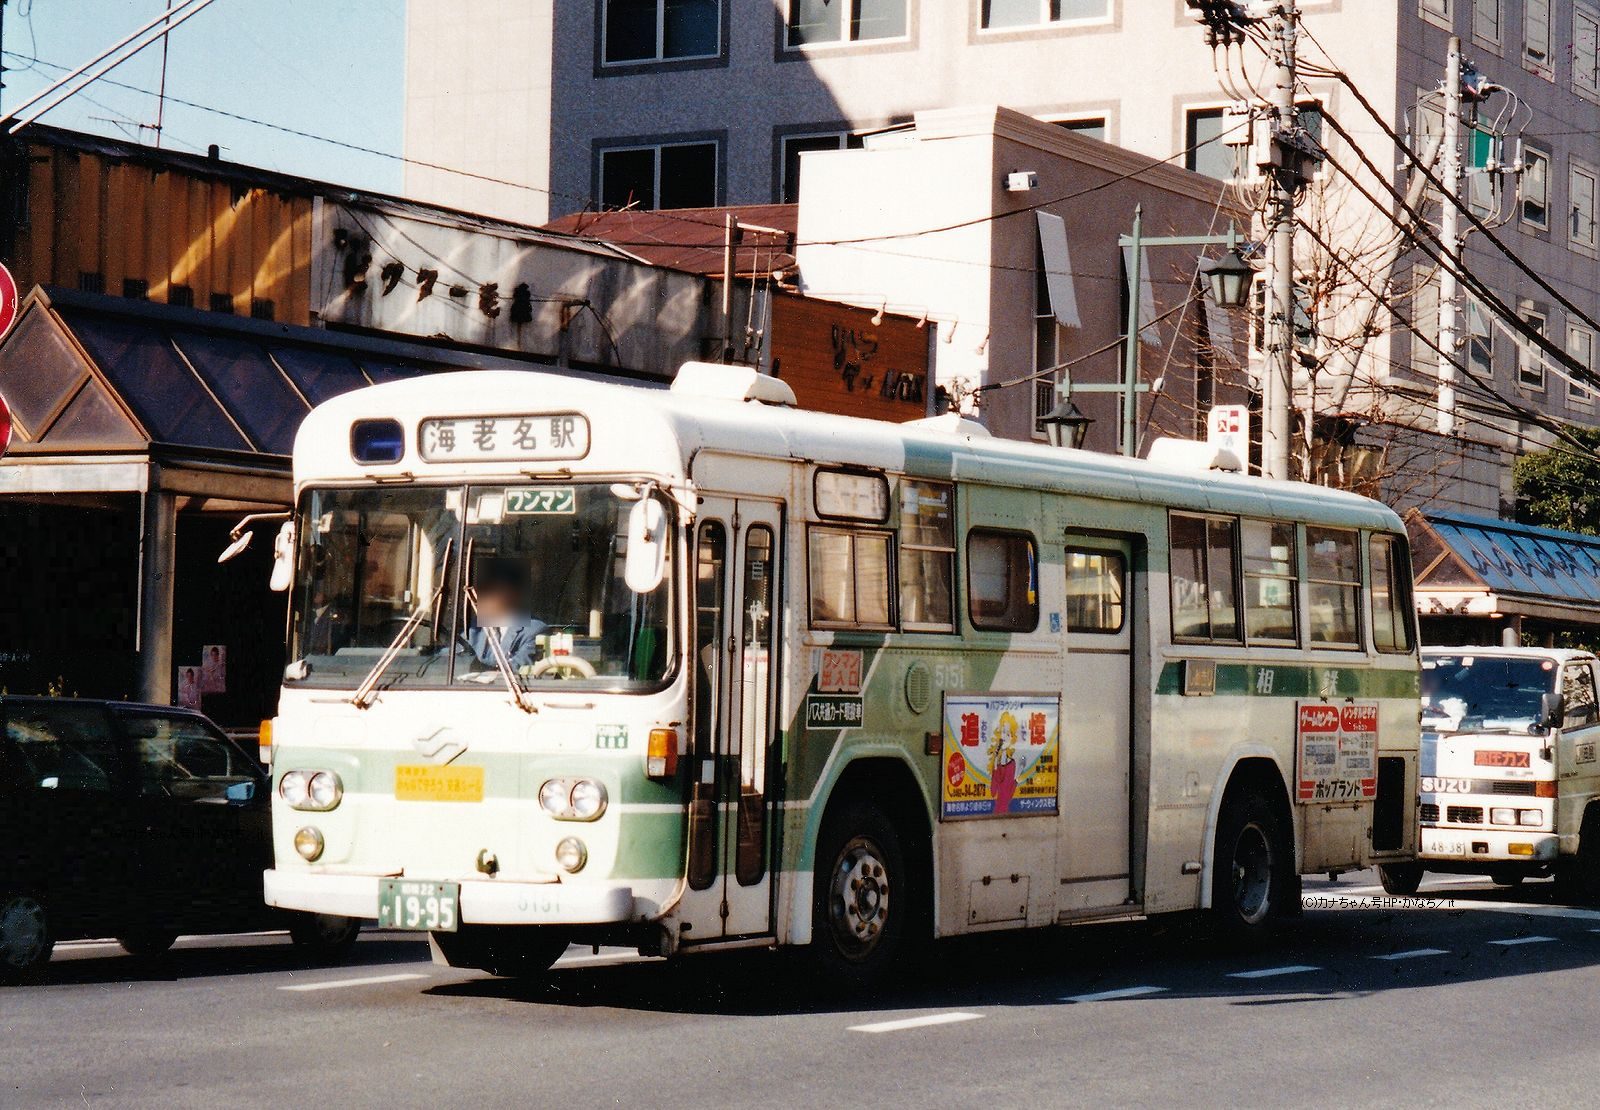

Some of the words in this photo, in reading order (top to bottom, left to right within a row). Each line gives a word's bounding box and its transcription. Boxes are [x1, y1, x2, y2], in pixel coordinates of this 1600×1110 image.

[429, 417, 575, 454] 海老名駅
[507, 490, 573, 512] ワンマン
[823, 651, 860, 670] ワンマン
[821, 670, 859, 687] 出入口
[1301, 709, 1338, 727] ゲームセンター
[960, 712, 980, 747] 追
